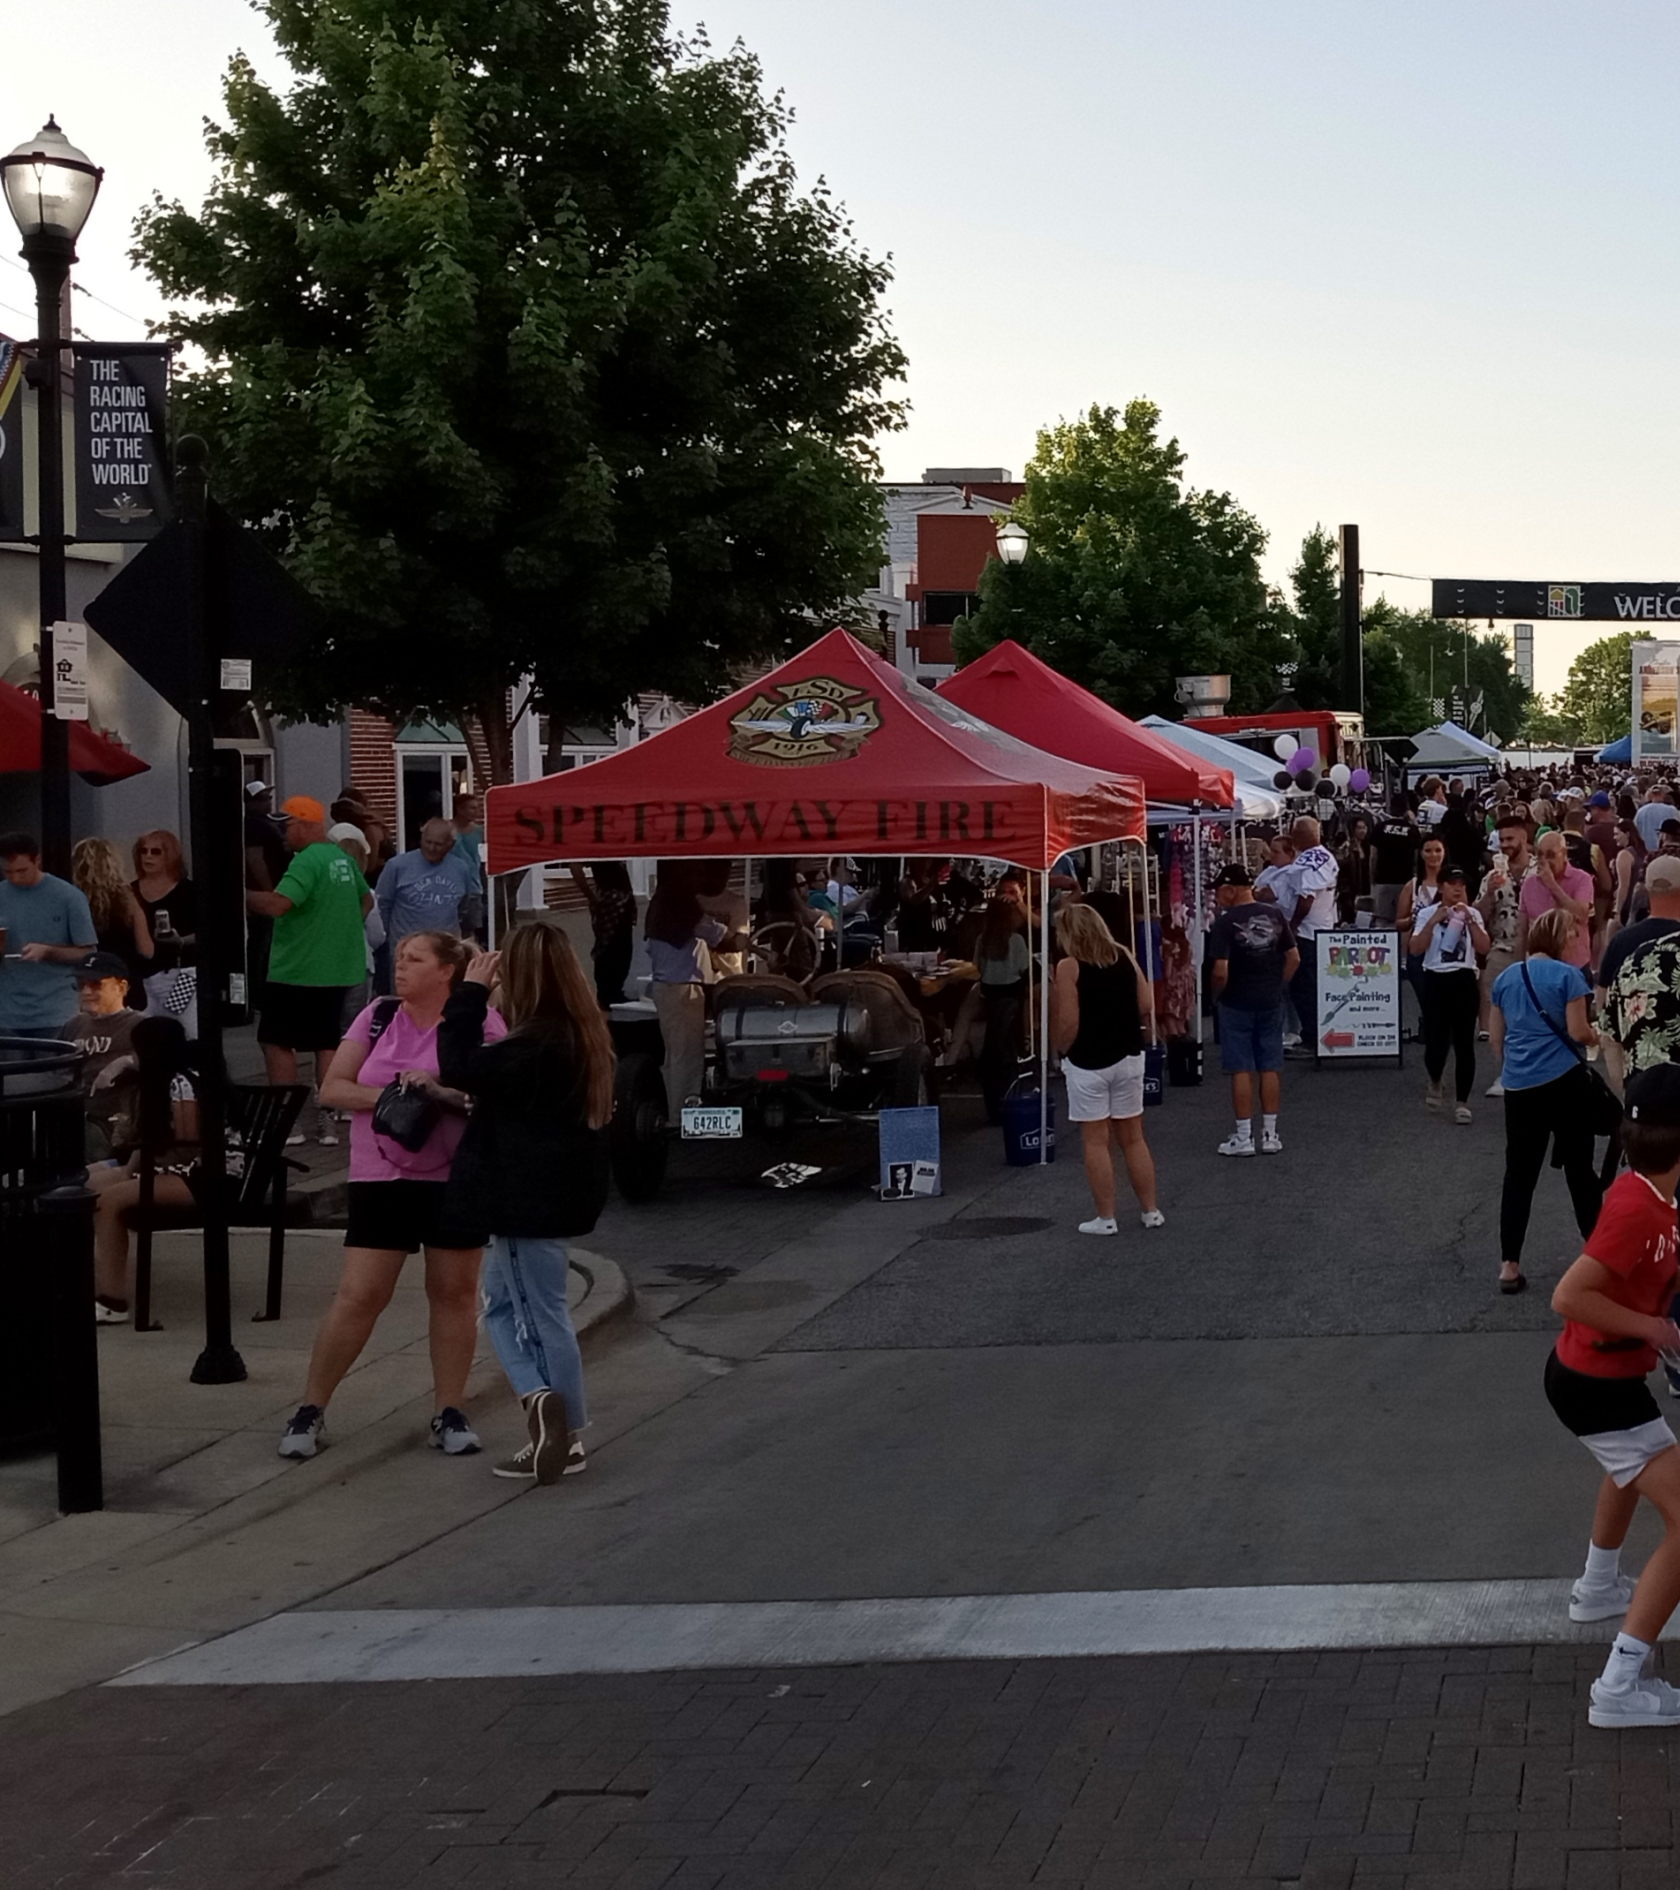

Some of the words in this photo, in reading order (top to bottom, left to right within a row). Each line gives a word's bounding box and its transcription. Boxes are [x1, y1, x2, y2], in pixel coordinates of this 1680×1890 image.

[89, 360, 120, 381] THE
[90, 386, 146, 407] RACING
[90, 412, 153, 433] CAPITAL
[91, 438, 111, 459] OF
[113, 438, 143, 459] THE
[92, 464, 150, 485] WORLD
[514, 801, 848, 846] SPEEDWAY
[876, 800, 1015, 842] FIRE
[1343, 934, 1387, 944] Painted
[1329, 946, 1391, 966] PARROT
[1325, 992, 1347, 1002] Face
[1349, 991, 1391, 1003] Painting
